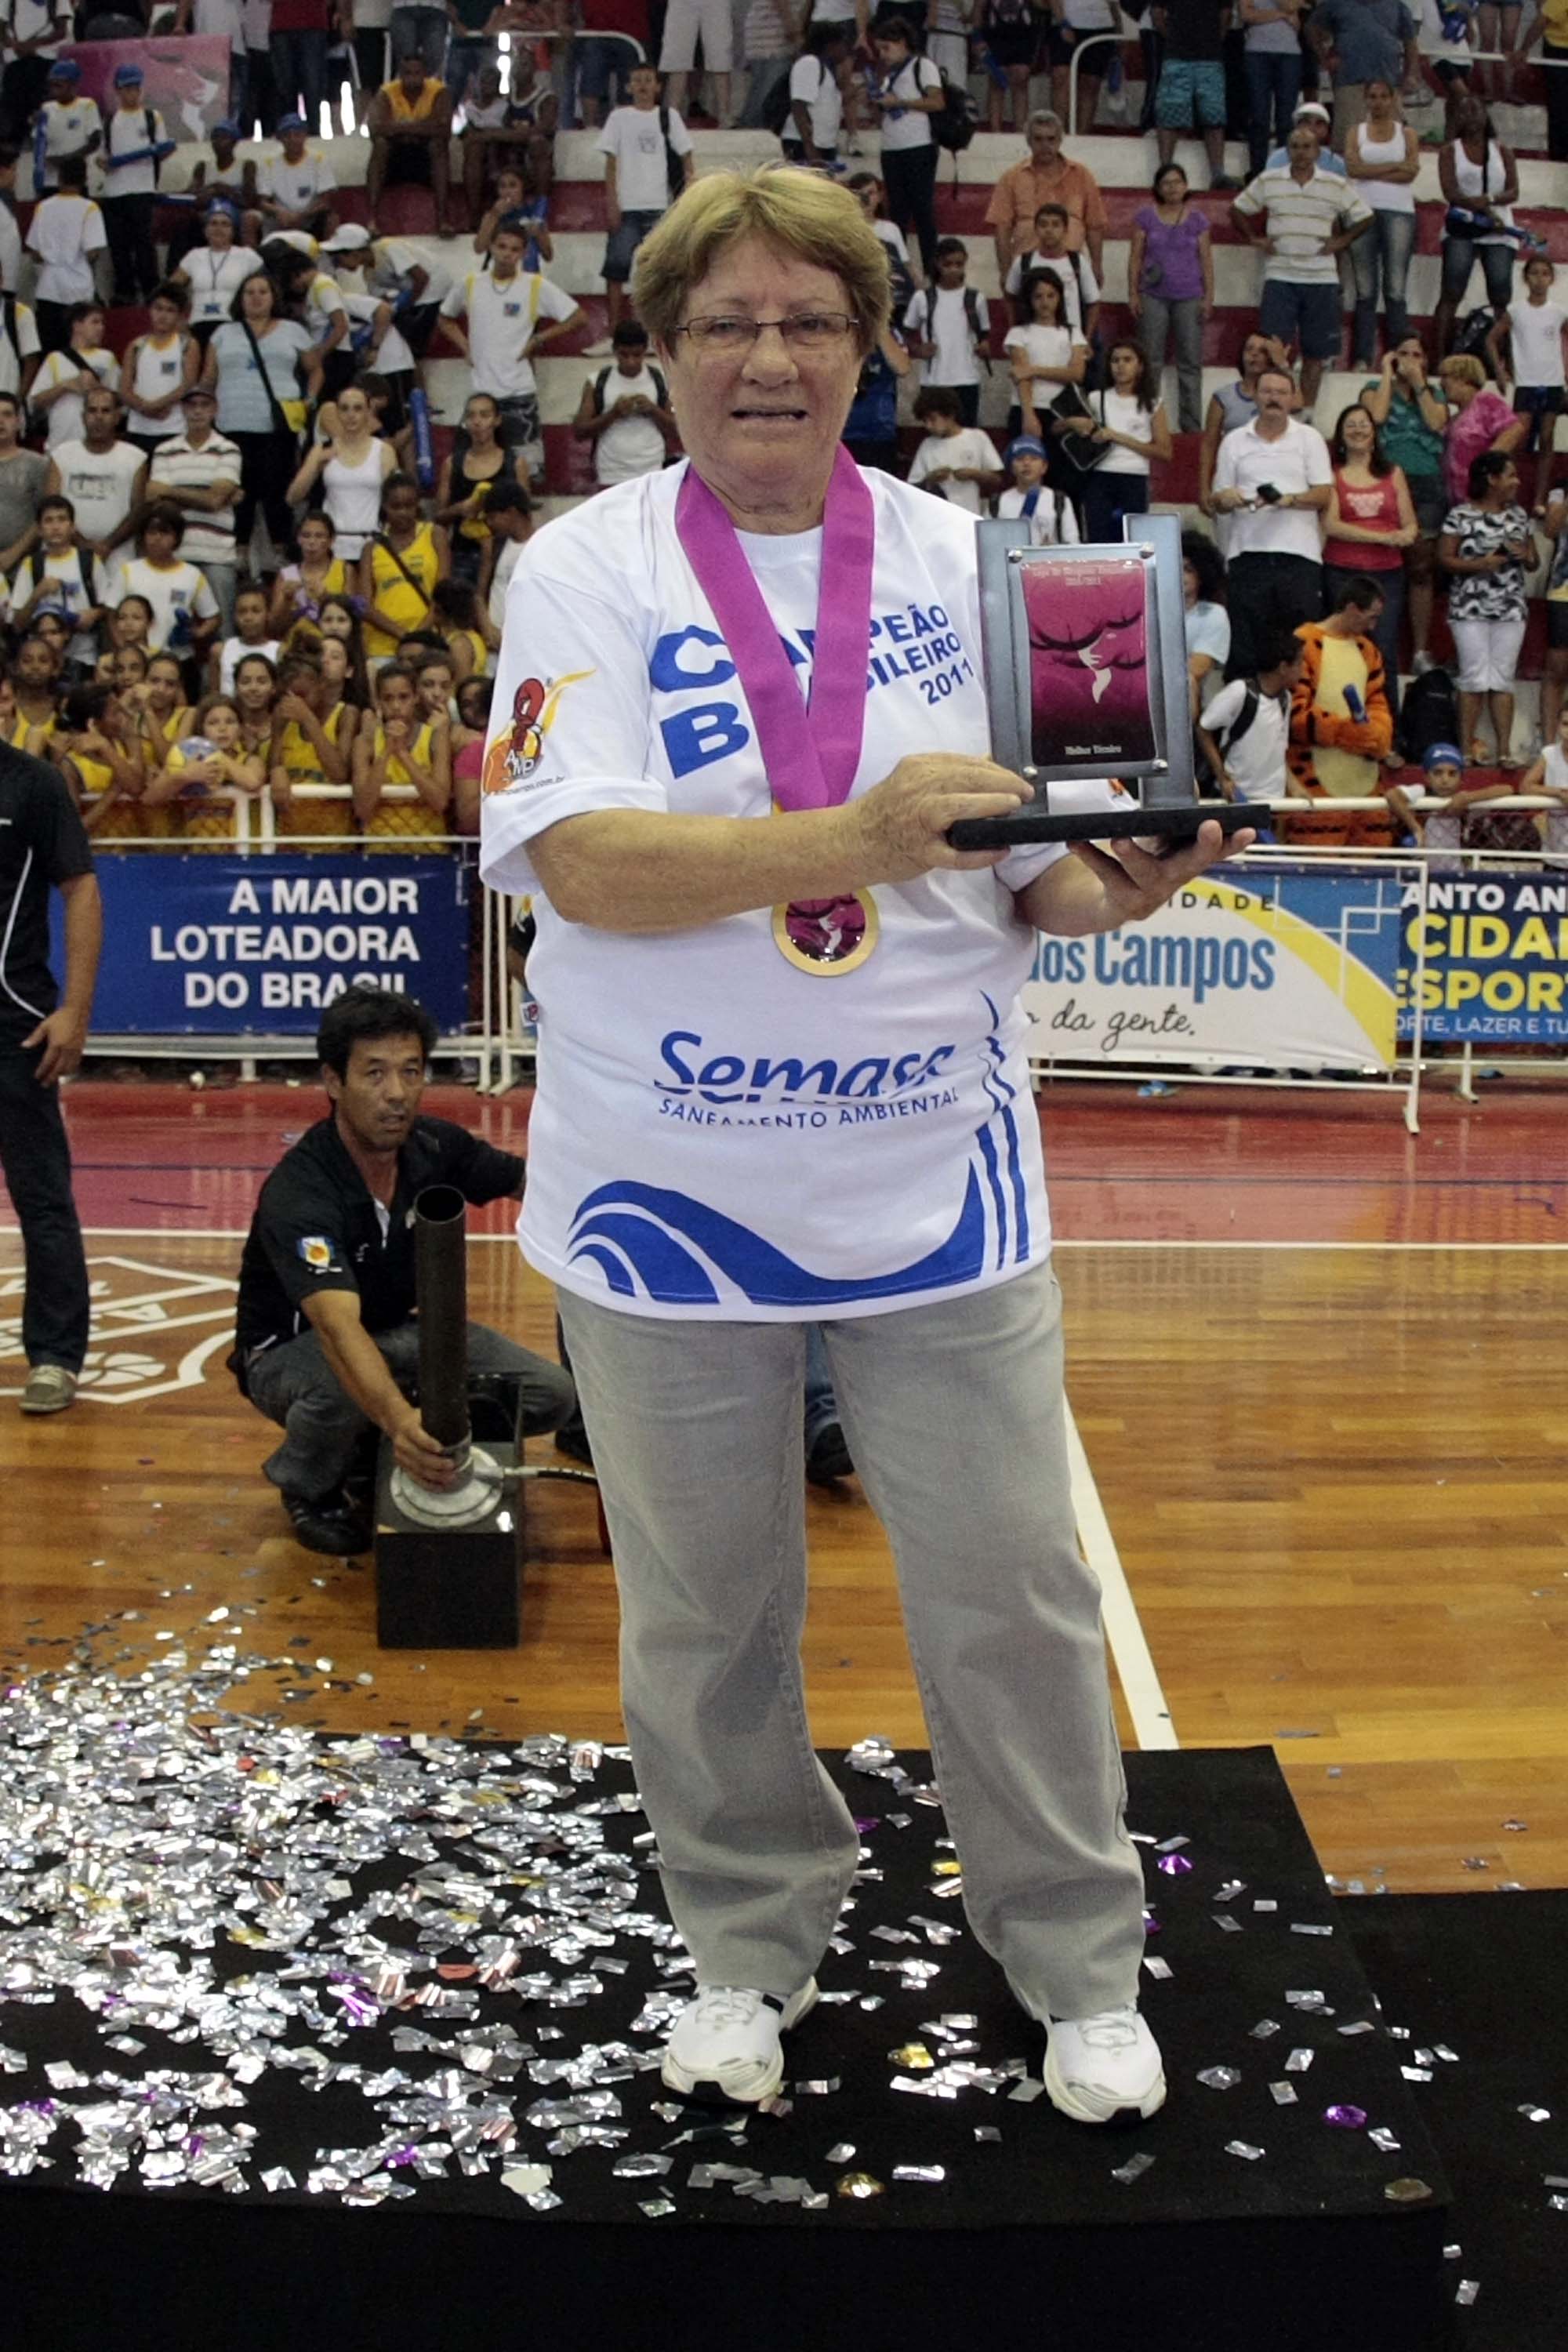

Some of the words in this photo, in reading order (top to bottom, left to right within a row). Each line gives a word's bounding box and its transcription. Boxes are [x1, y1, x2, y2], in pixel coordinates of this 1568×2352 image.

[920, 658, 975, 706] 2011
[228, 878, 260, 914] A
[271, 877, 419, 915] MAIOR
[150, 925, 420, 962] LOTEADORA
[1406, 912, 1568, 961] CIDA
[1094, 929, 1276, 1004] Campos
[184, 972, 249, 1009] DO
[1051, 998, 1096, 1033] da
[1100, 1002, 1196, 1053] gente.
[1455, 1016, 1523, 1036] LAZER
[1526, 1018, 1540, 1035] E
[839, 1086, 960, 1126] AMBIENTAL
